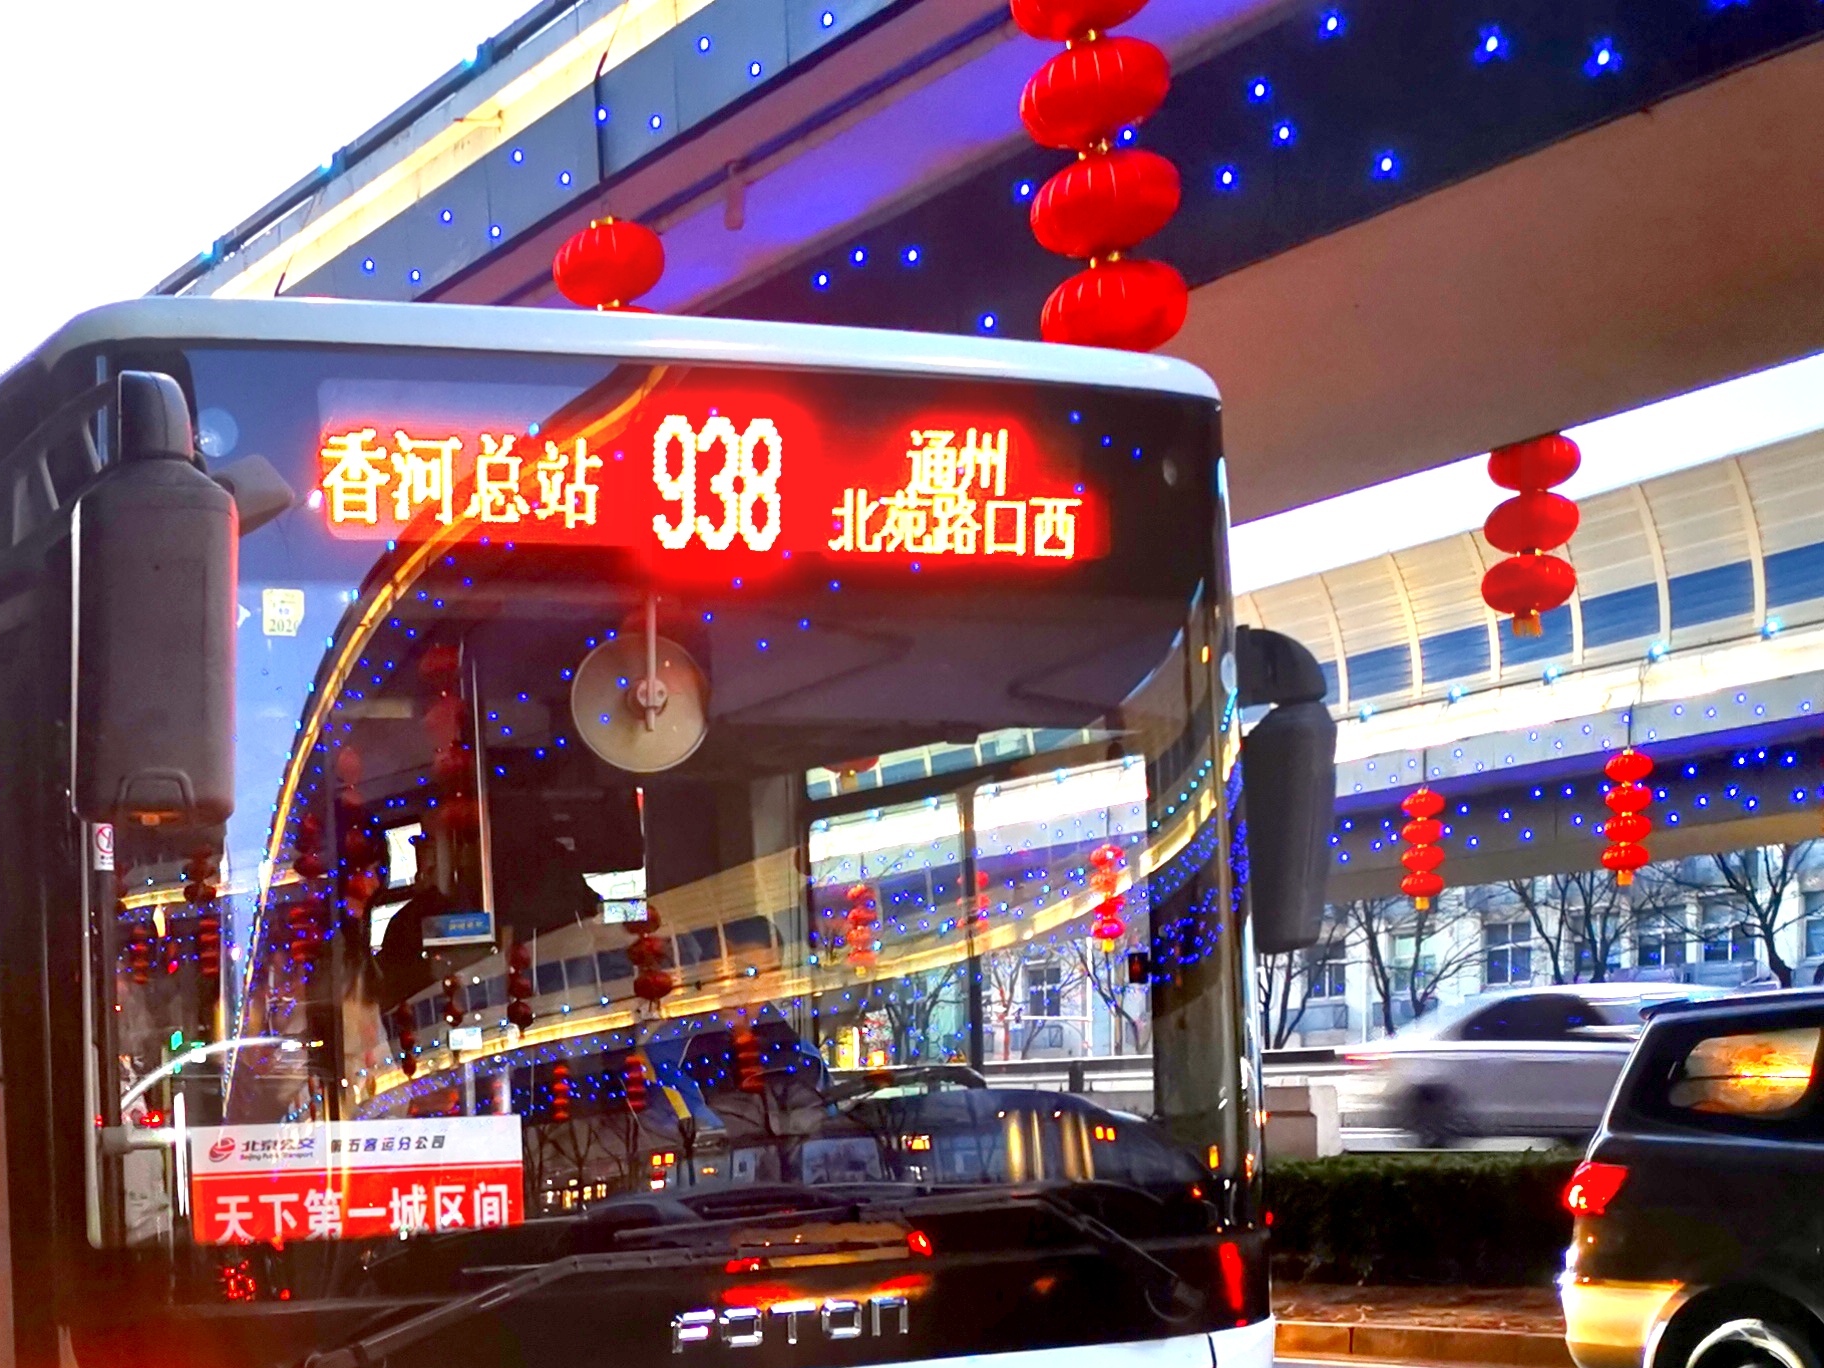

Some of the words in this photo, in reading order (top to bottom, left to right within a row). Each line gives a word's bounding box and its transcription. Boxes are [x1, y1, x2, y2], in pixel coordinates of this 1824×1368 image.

[322, 428, 604, 529] 香河总站
[652, 414, 782, 552] 938
[907, 427, 1010, 496] 通州
[828, 490, 1084, 559] 北苑路口西
[215, 1181, 510, 1245] 天下第一城区间
